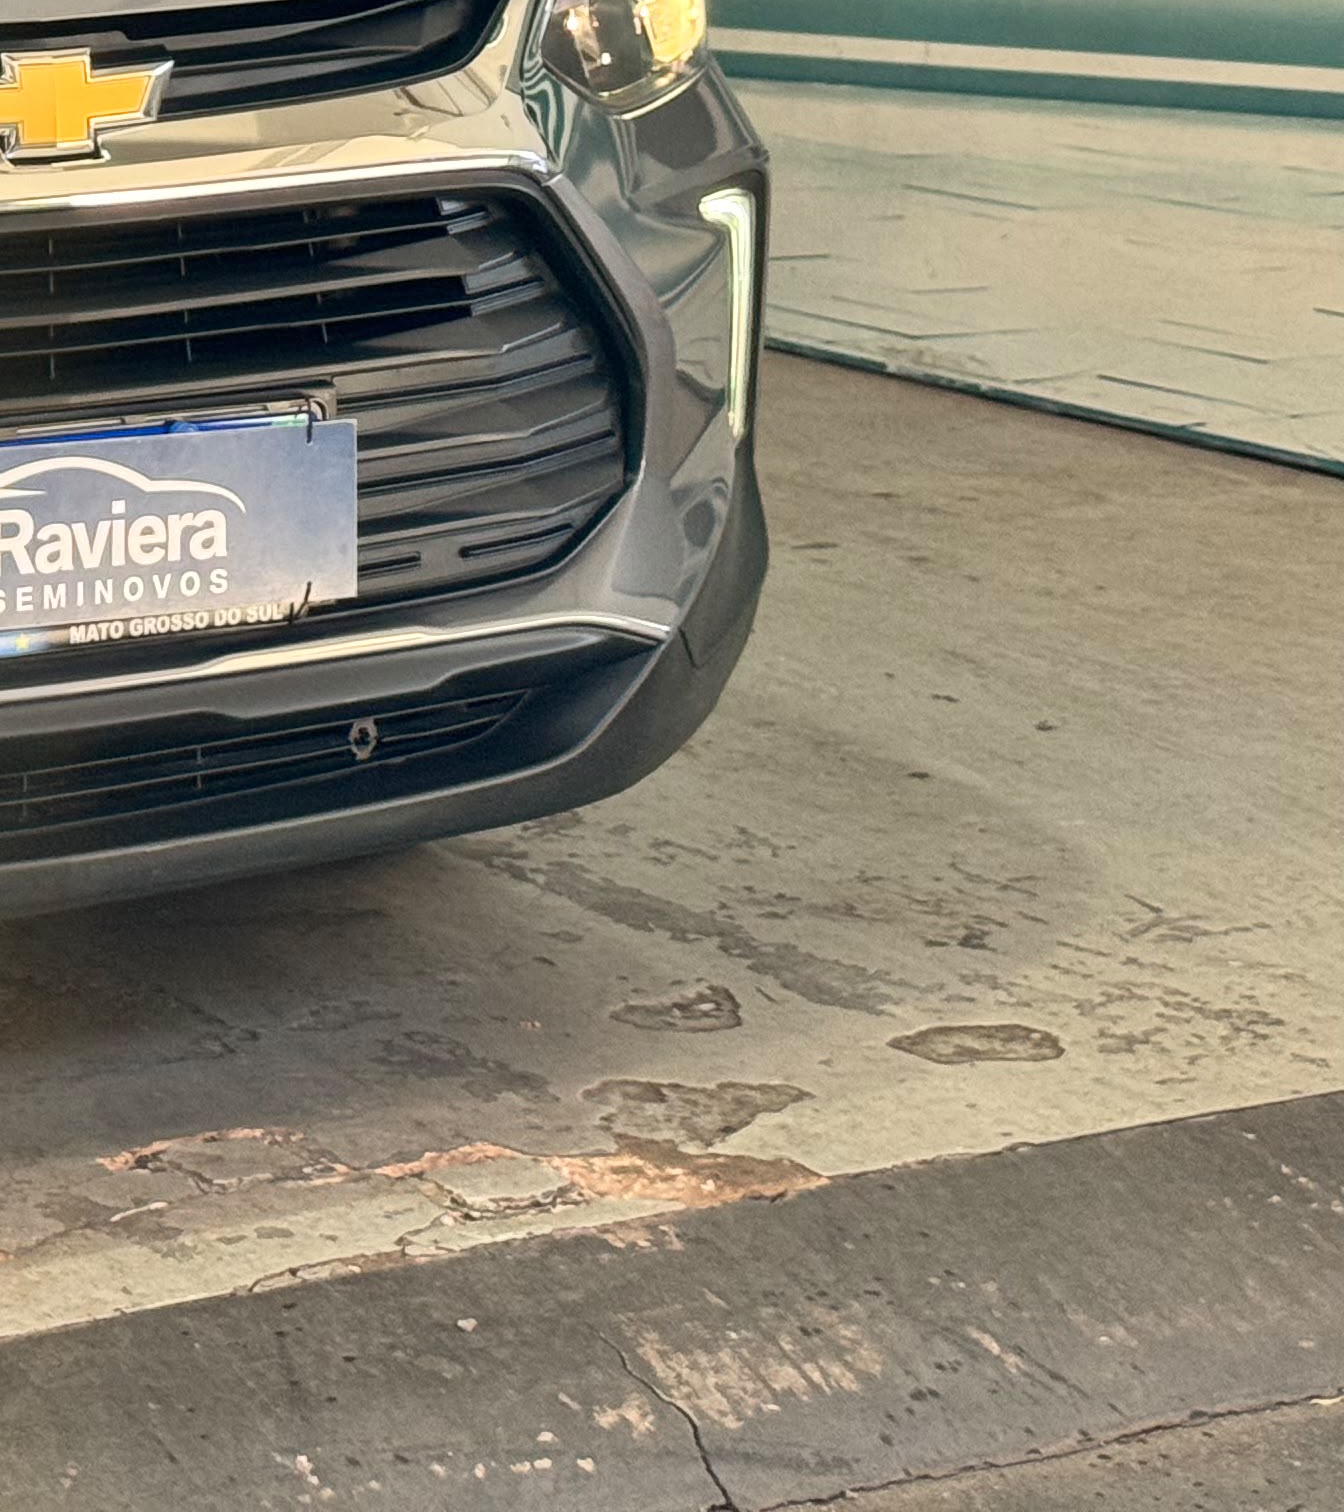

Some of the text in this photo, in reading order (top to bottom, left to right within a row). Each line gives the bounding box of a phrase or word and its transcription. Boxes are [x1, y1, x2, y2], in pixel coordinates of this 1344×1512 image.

[69, 602, 285, 644] MATO GROSSO DO SUL
